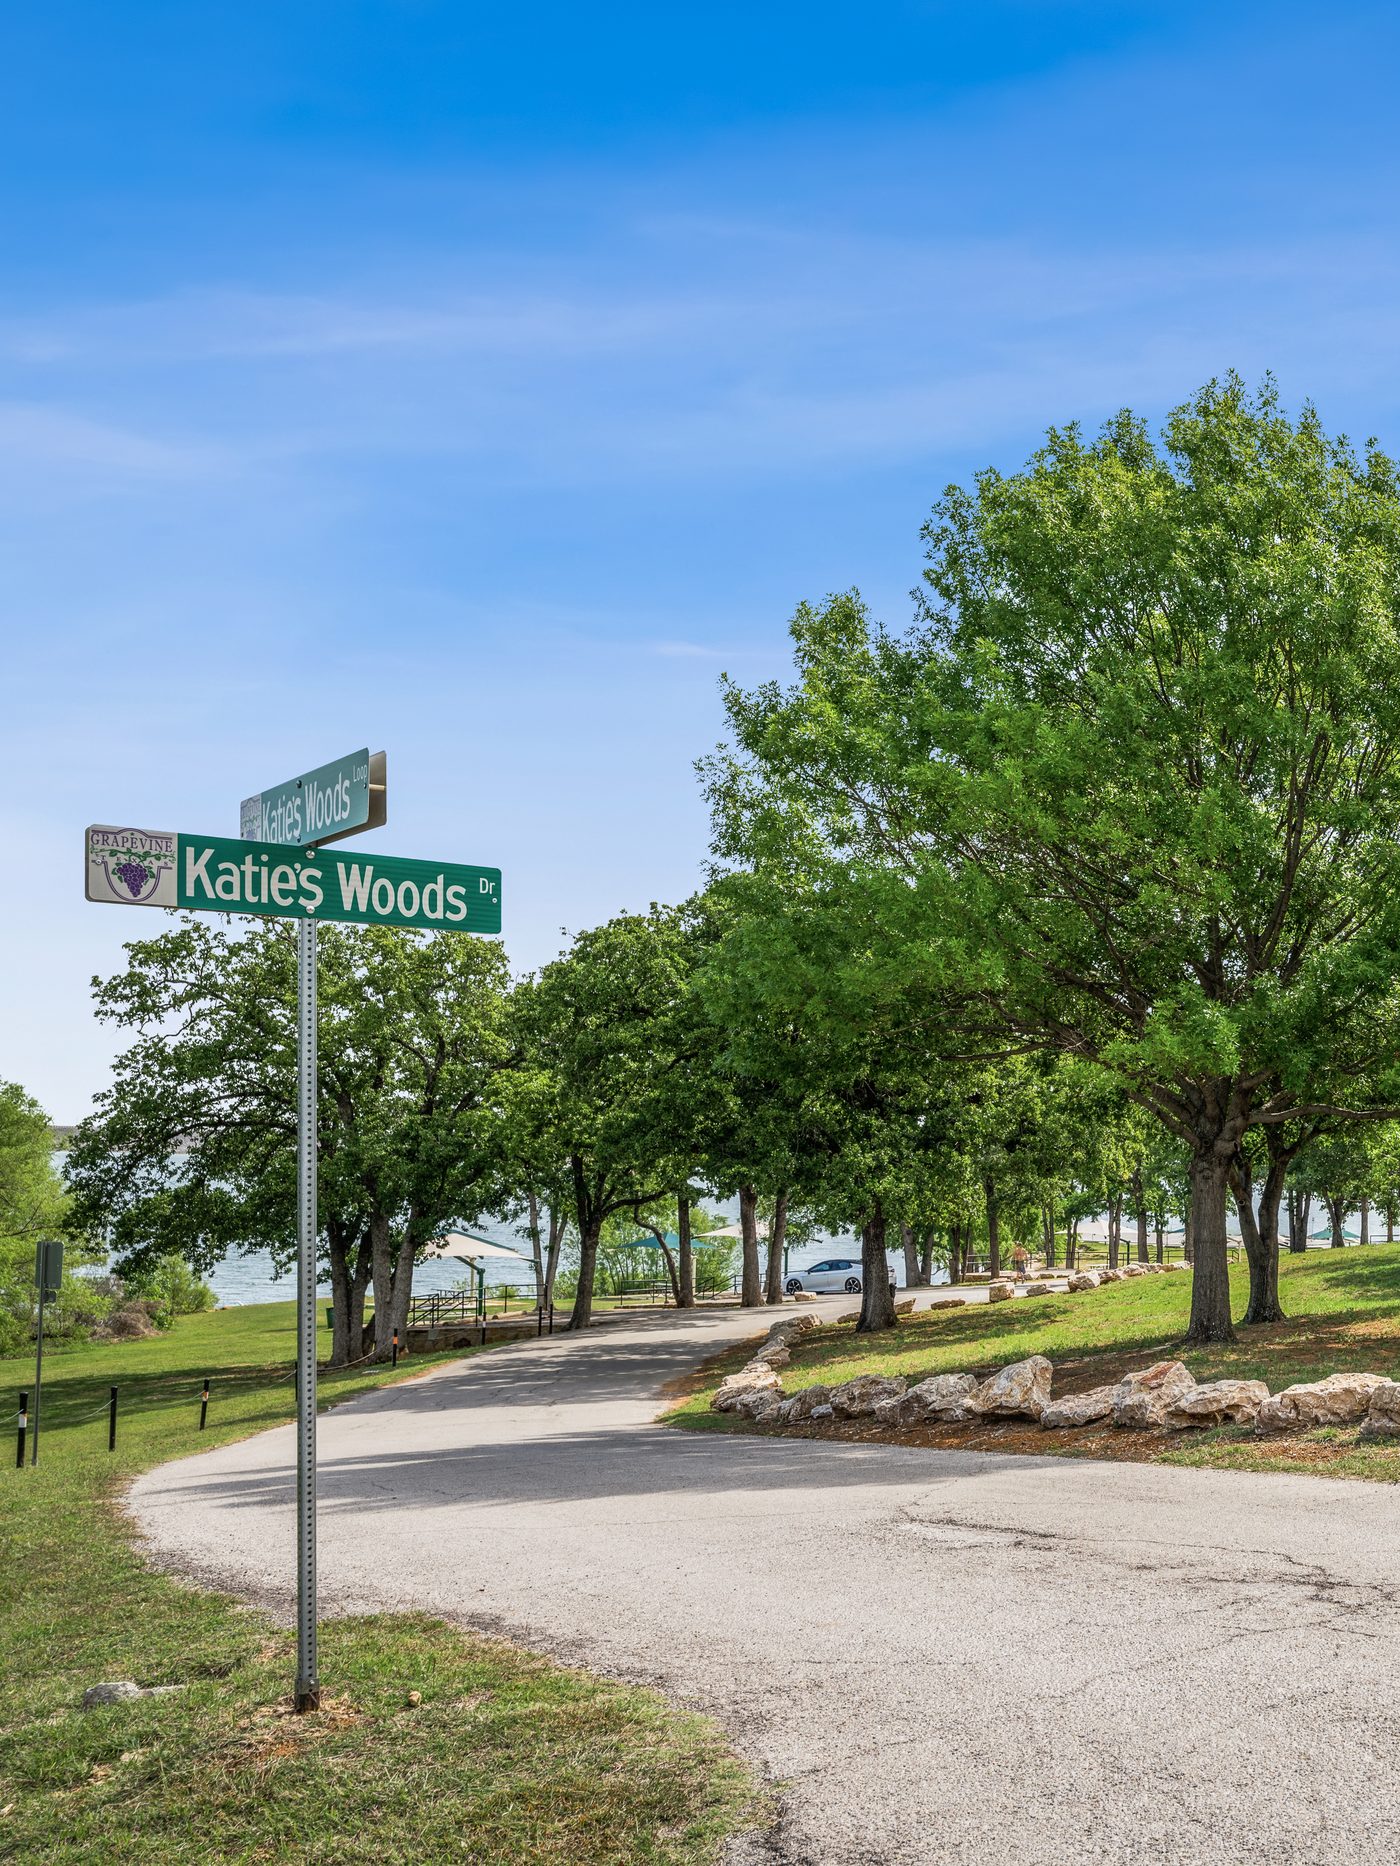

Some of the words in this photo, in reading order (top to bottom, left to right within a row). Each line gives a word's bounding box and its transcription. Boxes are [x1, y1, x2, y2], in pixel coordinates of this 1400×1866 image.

[262, 795, 301, 843] Katie's
[305, 772, 350, 832] Woods
[353, 764, 367, 782] Loop
[90, 833, 173, 852] GRAPEVINE
[186, 846, 324, 909] Katie's
[336, 862, 468, 921] Woods
[479, 877, 496, 894] Dr
